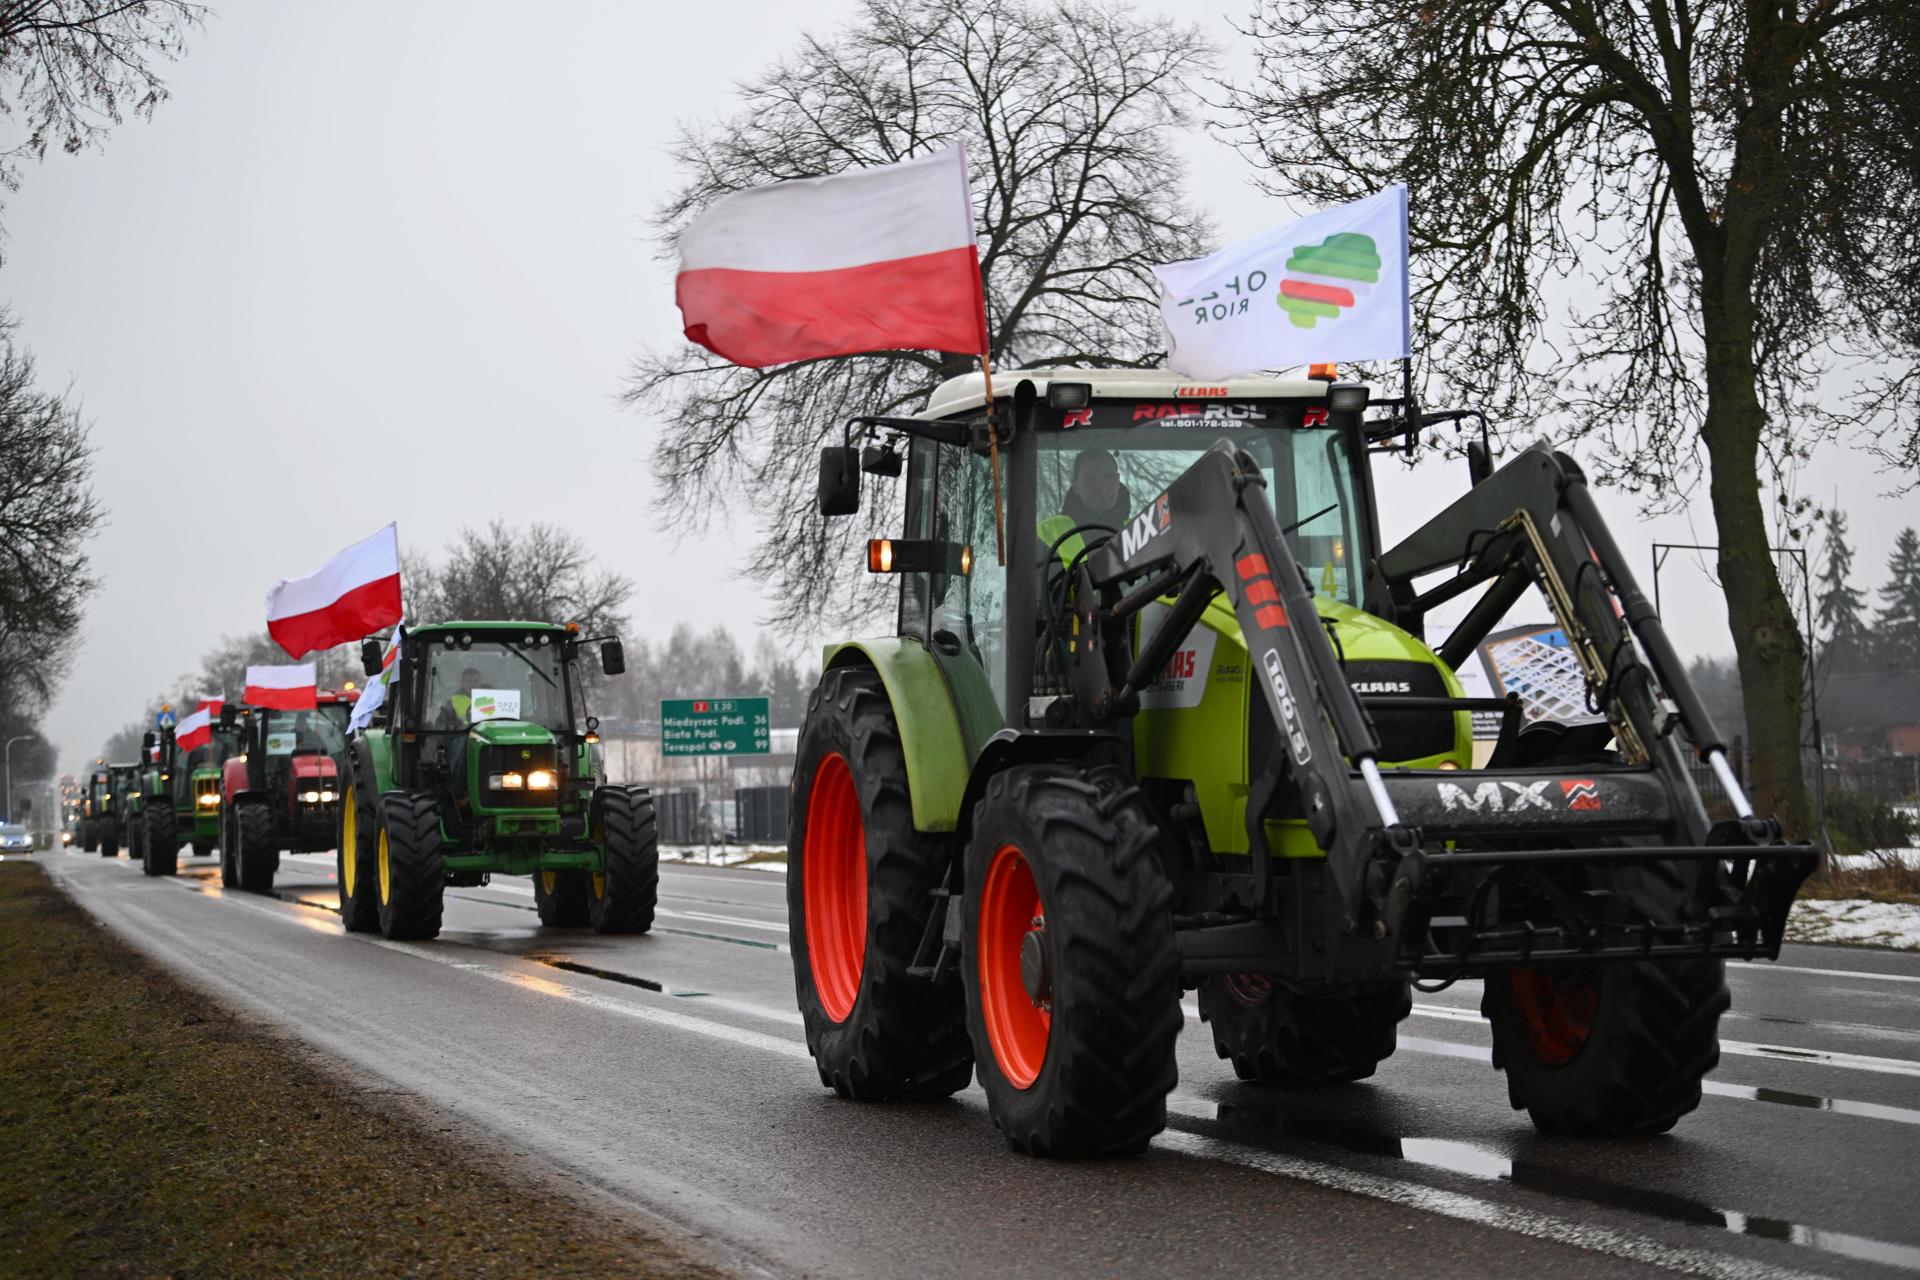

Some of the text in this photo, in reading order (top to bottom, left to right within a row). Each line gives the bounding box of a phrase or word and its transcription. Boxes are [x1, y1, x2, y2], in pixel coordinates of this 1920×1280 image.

[1179, 387, 1228, 397] CLAAS
[1120, 503, 1158, 562] MX
[1350, 682, 1410, 693] CLAAS
[721, 716, 747, 726] Podl.
[753, 715, 767, 725] 36
[694, 729, 719, 738] Podl.
[753, 729, 767, 737] 60
[664, 742, 706, 752] Terespol
[755, 741, 768, 750] 99
[1436, 780, 1553, 812] MX
